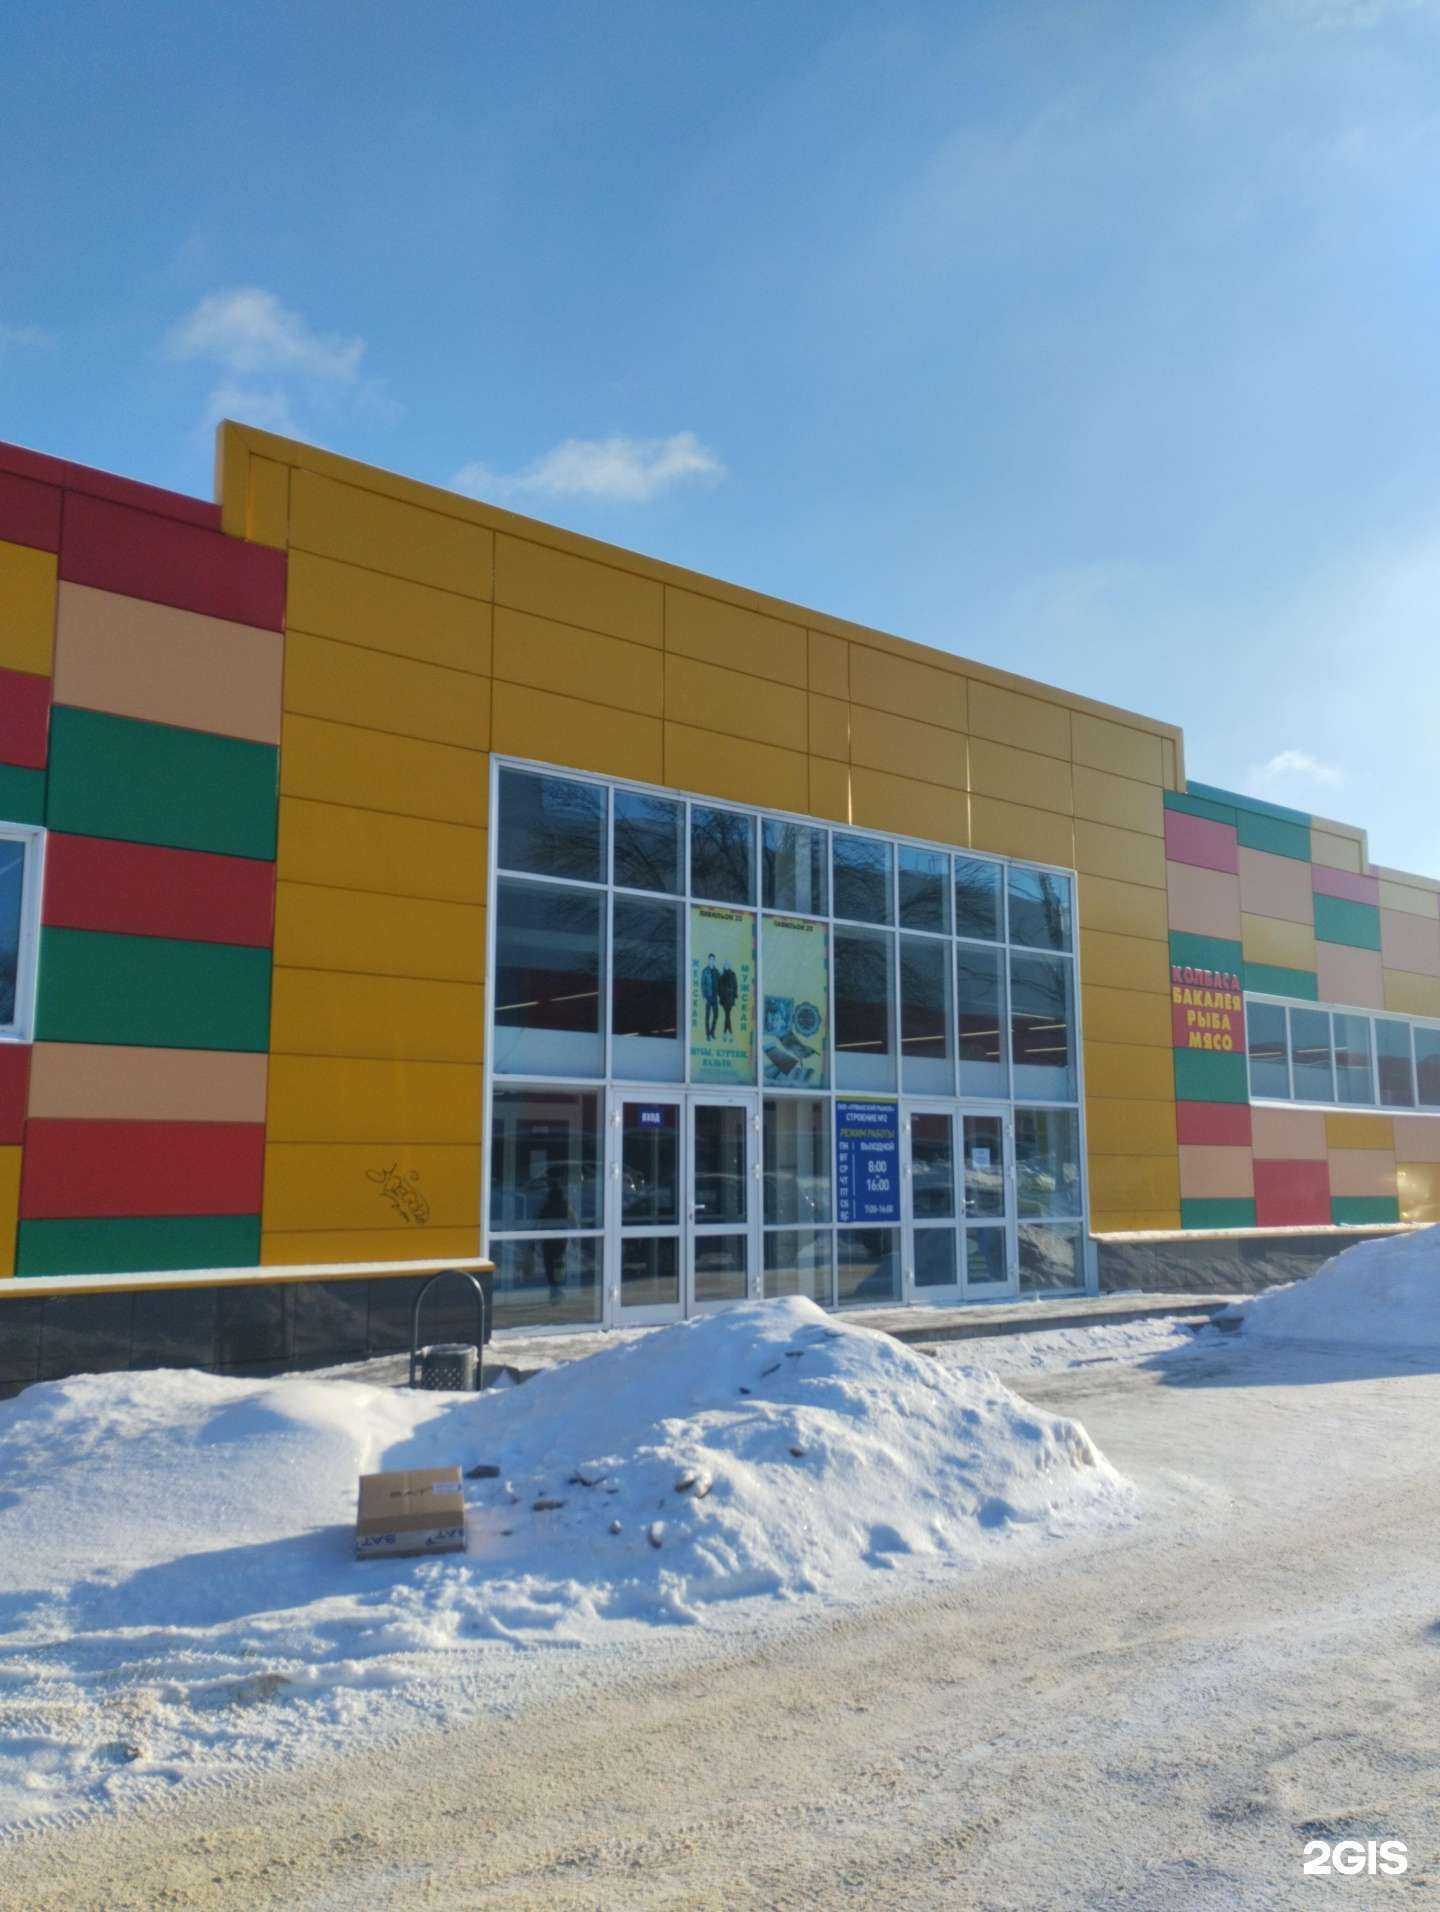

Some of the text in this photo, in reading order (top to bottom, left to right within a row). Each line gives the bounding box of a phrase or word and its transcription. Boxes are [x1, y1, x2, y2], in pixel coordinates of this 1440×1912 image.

[1171, 965, 1240, 991] КОЛБАСА
[740, 964, 750, 1032] МУЖСКАЯ
[1172, 986, 1241, 1011] БАКАЛЕЯ
[1186, 1008, 1231, 1031] РЫБА
[1188, 1031, 1233, 1051] МЯСО
